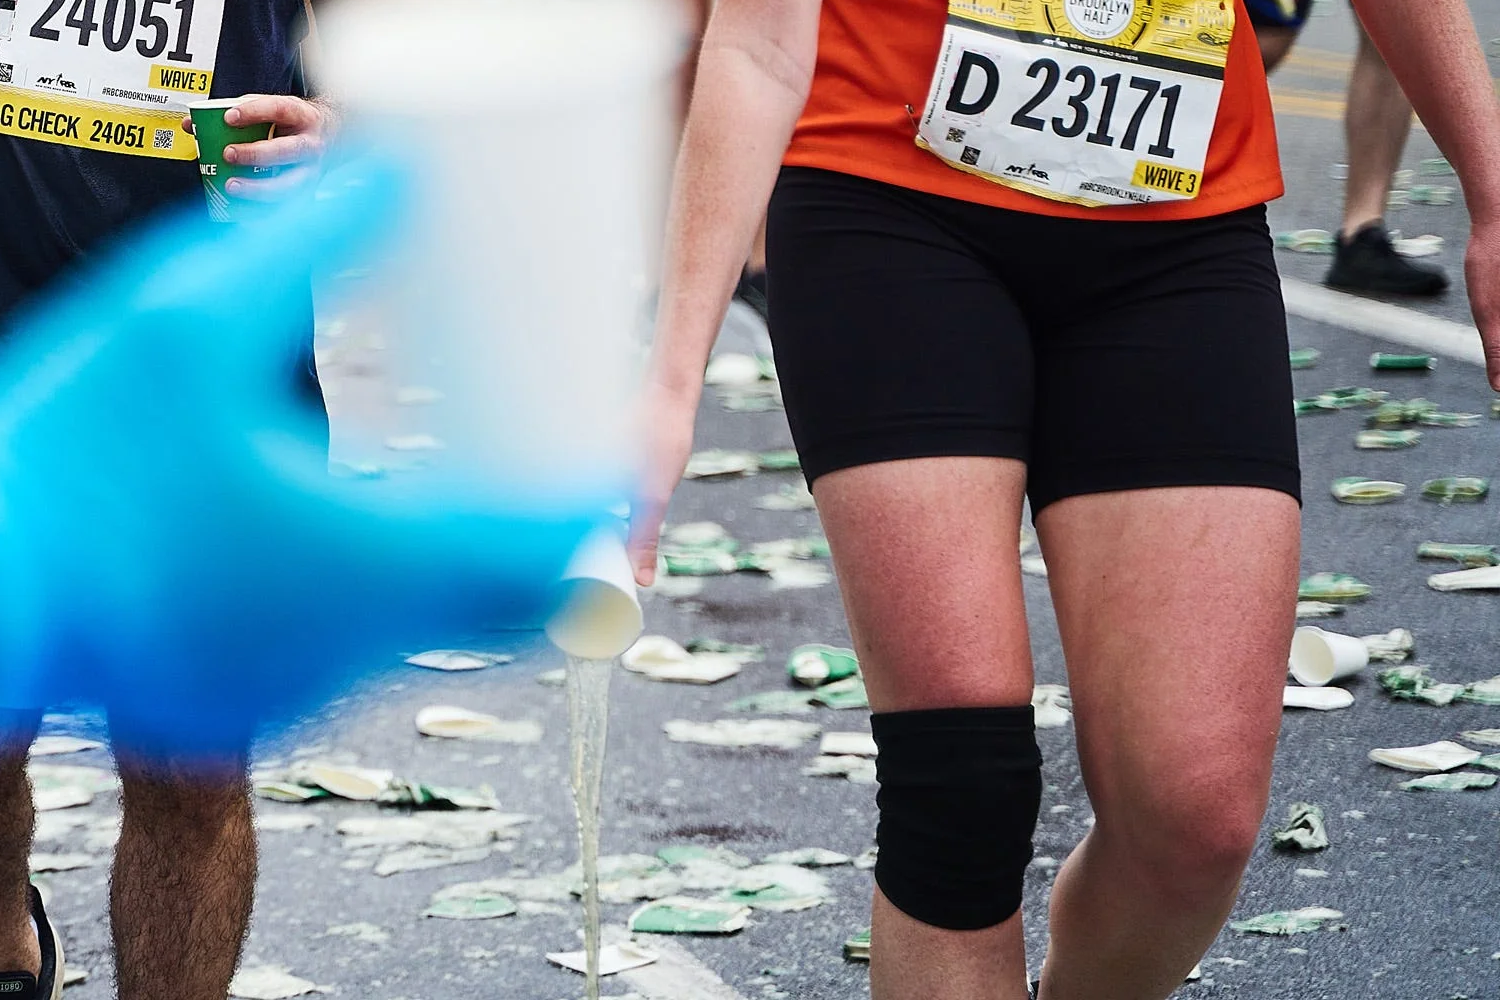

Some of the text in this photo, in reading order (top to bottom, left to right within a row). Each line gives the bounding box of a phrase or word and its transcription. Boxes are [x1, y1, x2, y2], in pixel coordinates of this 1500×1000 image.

[1083, 9, 1114, 25] HALF
[160, 68, 207, 91] WAVE 3
[102, 87, 168, 104] #RBCBROOKLYNHALF
[945, 50, 1182, 158] D 23171
[18, 107, 81, 139] CHECK
[90, 119, 145, 149] 24051
[1144, 165, 1197, 193] WAVE 3
[0, 982, 20, 991] 1080
